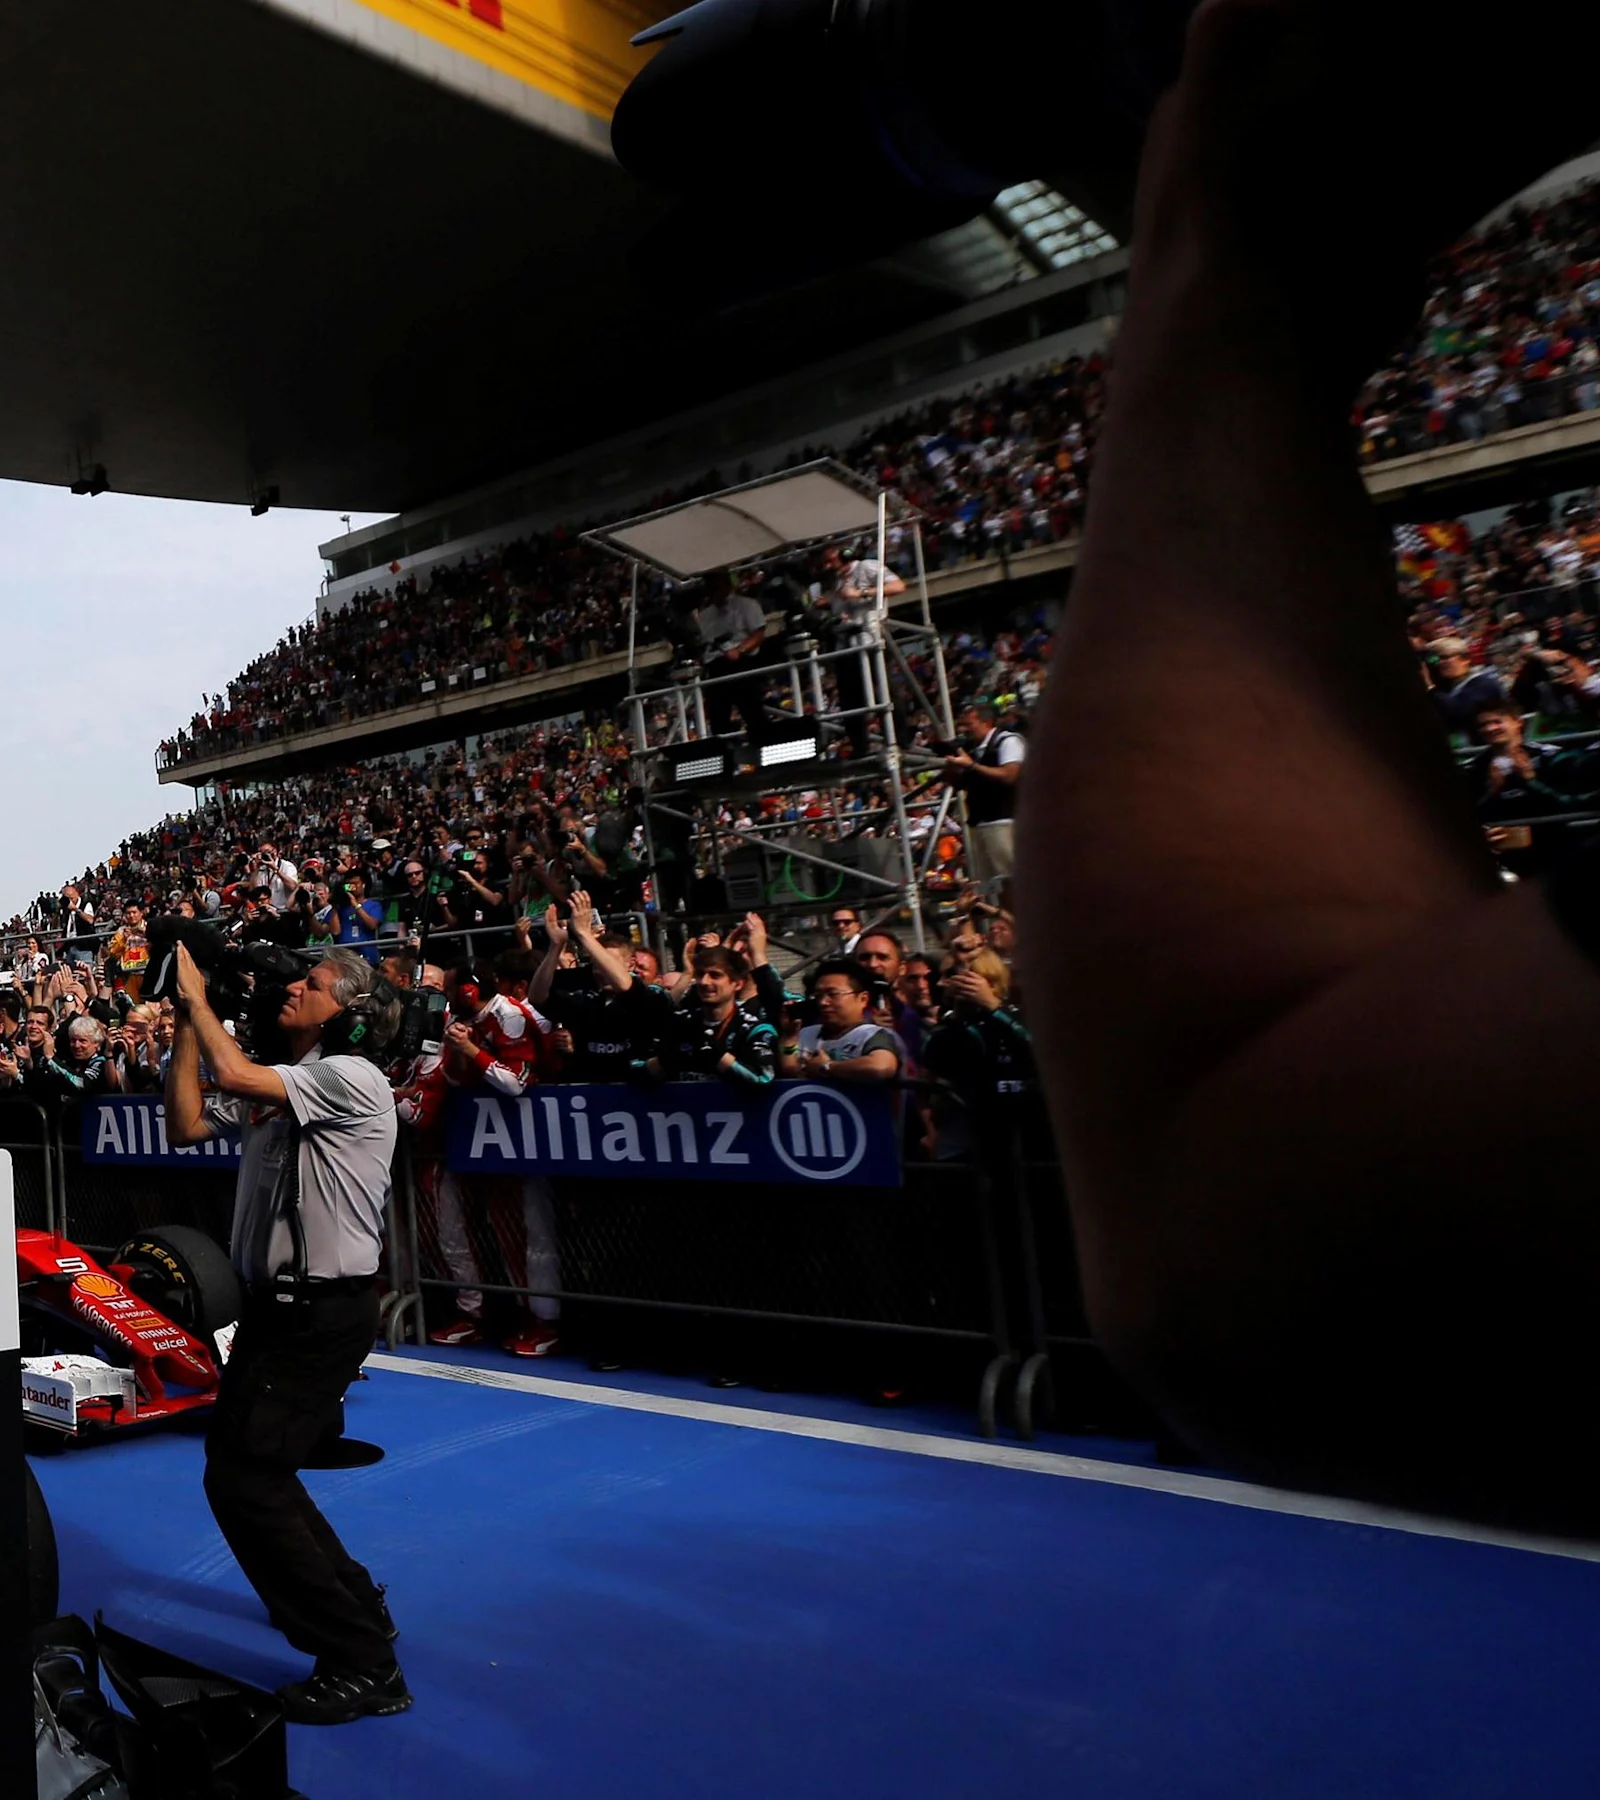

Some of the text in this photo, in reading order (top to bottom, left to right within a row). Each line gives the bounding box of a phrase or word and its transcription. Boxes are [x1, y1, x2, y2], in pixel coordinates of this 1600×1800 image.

[96, 1104, 242, 1156] Alli
[469, 1095, 750, 1165] Allianz
[55, 1256, 90, 1274] 5
[136, 1327, 180, 1340] MAHLE
[152, 1336, 188, 1351] telcel
[20, 1388, 71, 1411] ntander
